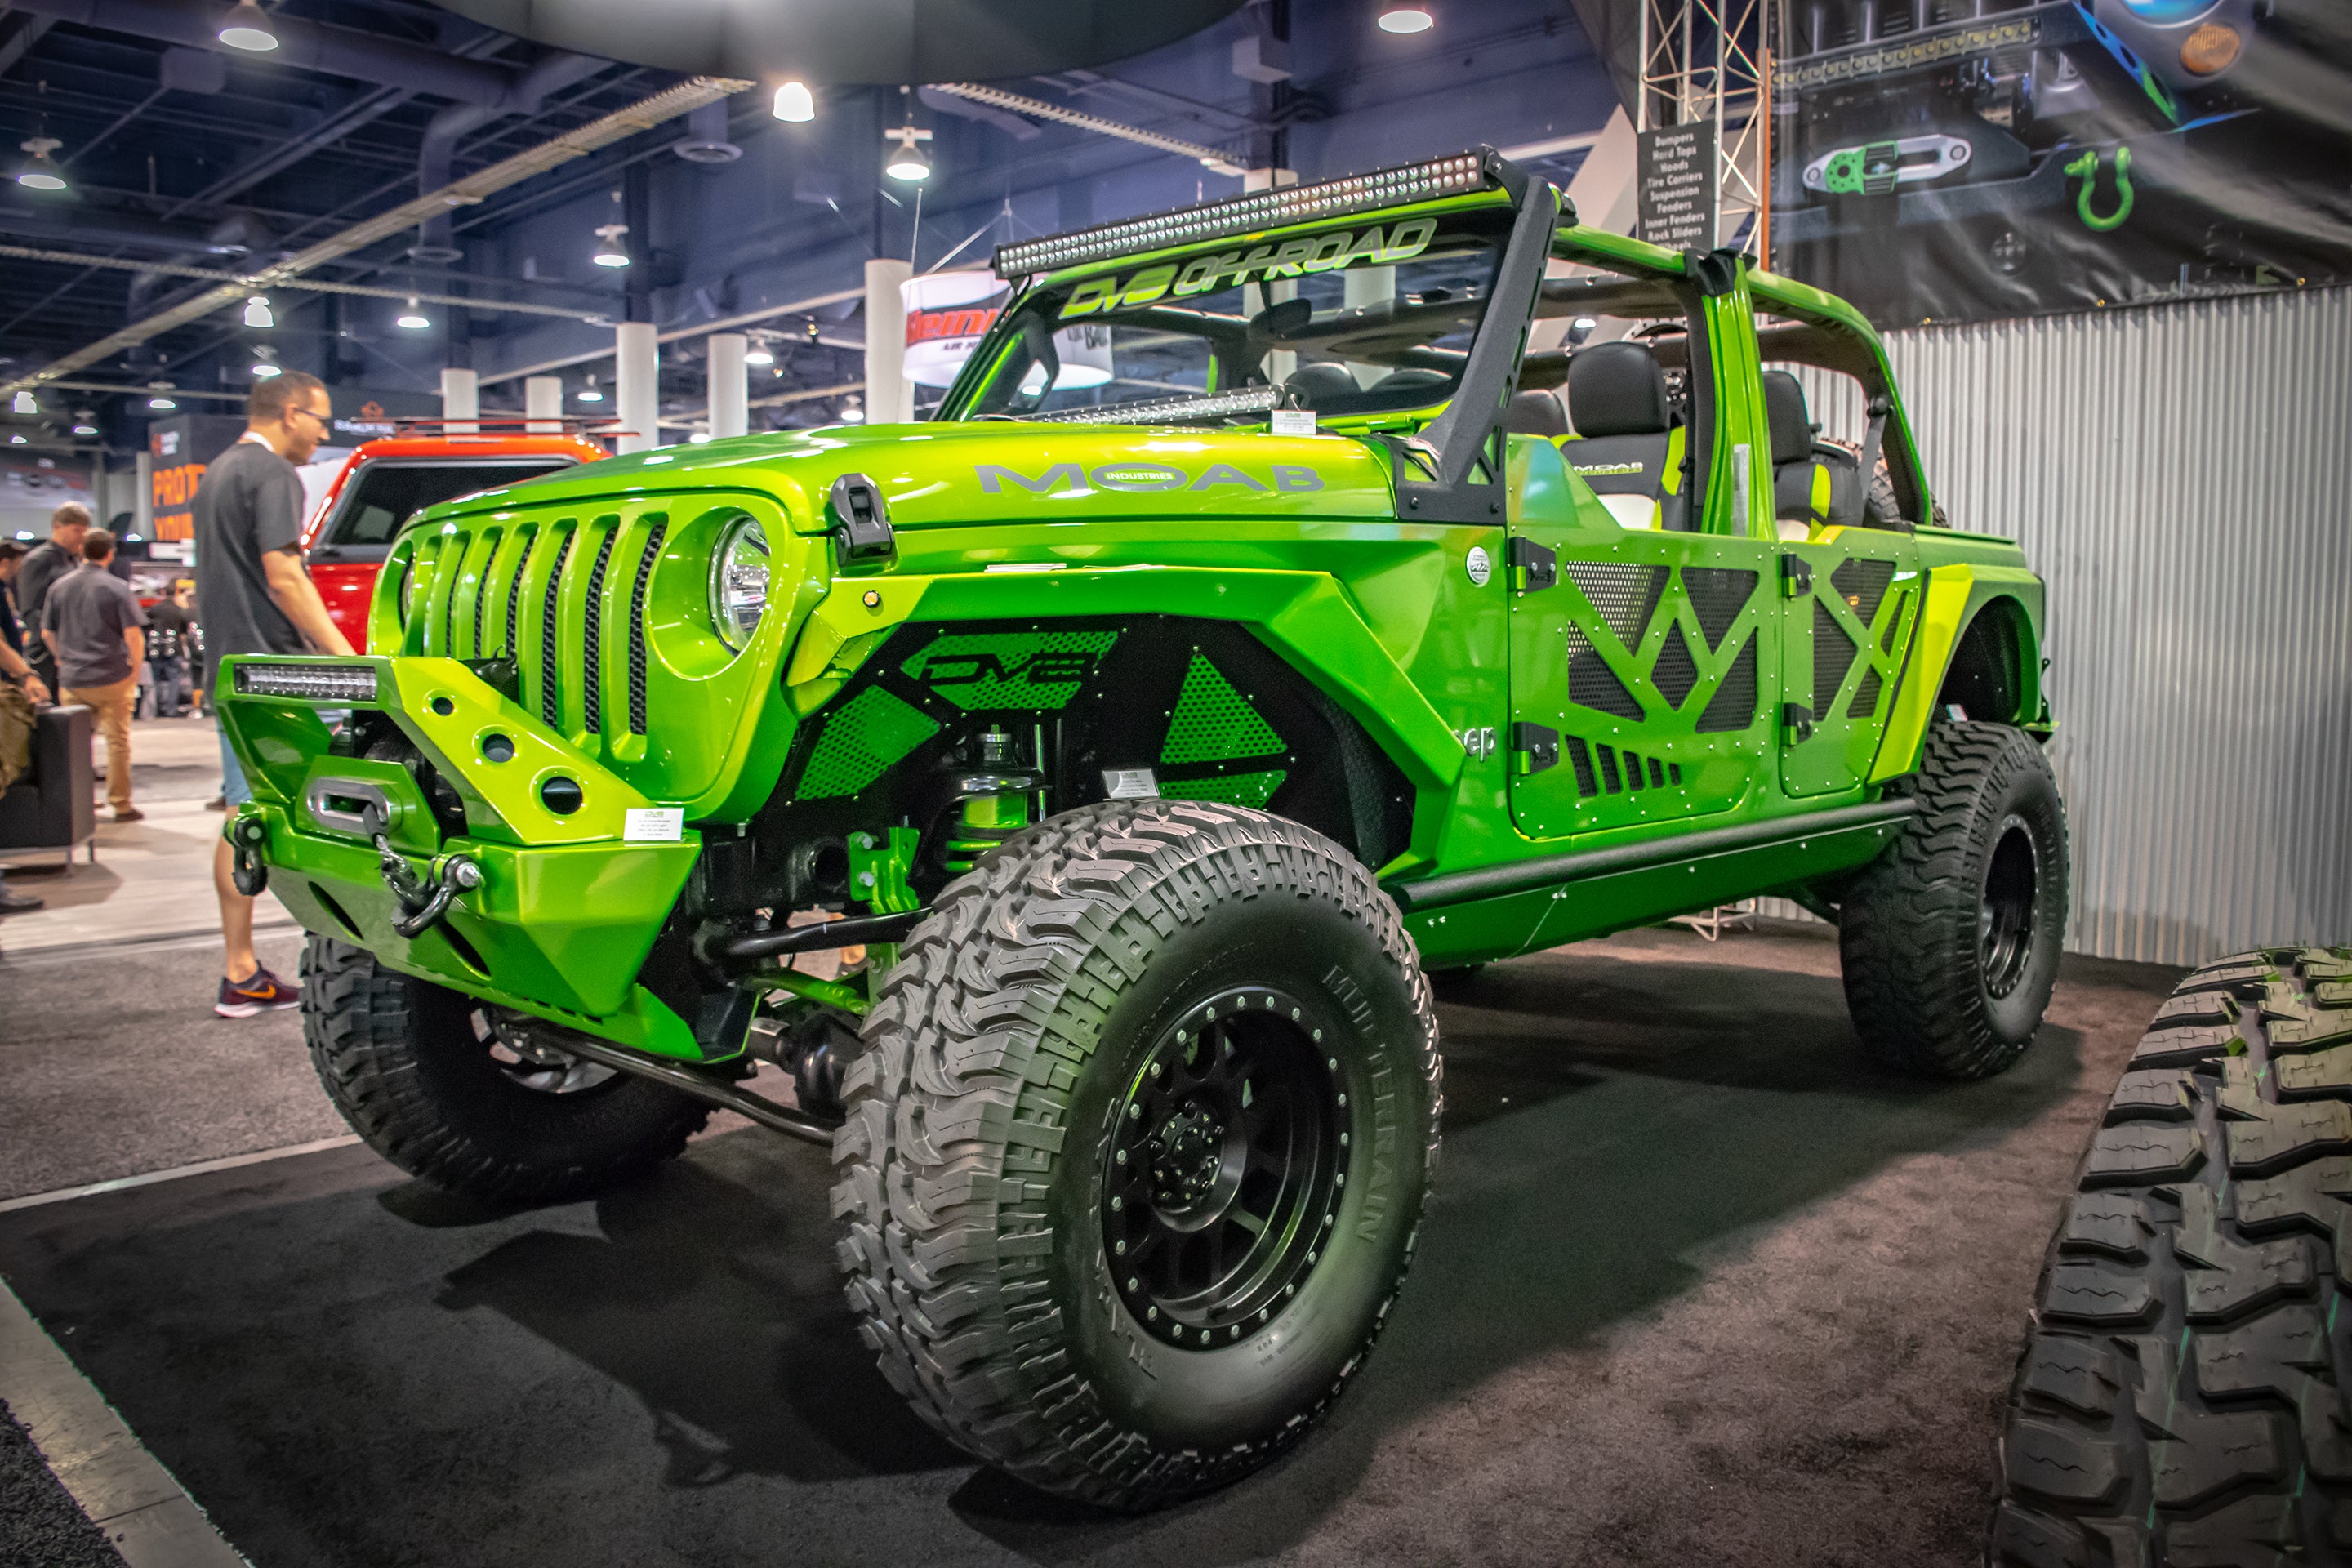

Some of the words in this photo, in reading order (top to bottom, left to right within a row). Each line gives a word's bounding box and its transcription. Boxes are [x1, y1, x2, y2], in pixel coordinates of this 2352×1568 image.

[1655, 133, 1695, 147] Bumpers
[1652, 148, 1674, 161] Hard
[1677, 146, 1697, 158] Tops
[1660, 159, 1689, 173] Hoods
[1647, 177, 1664, 188] Tire
[1667, 172, 1703, 185] Carriers
[1650, 187, 1699, 202] Suspension
[1657, 201, 1692, 213] Fenders
[1645, 218, 1668, 229] Inner
[1669, 212, 1705, 225] Fenders
[1648, 229, 1670, 242] Rock
[1672, 226, 1702, 238] Sliders
[974, 462, 1325, 493] MOAB
[1106, 472, 1174, 480] INDUSTRIES
[1356, 1043, 1396, 1243] TERRAIN
